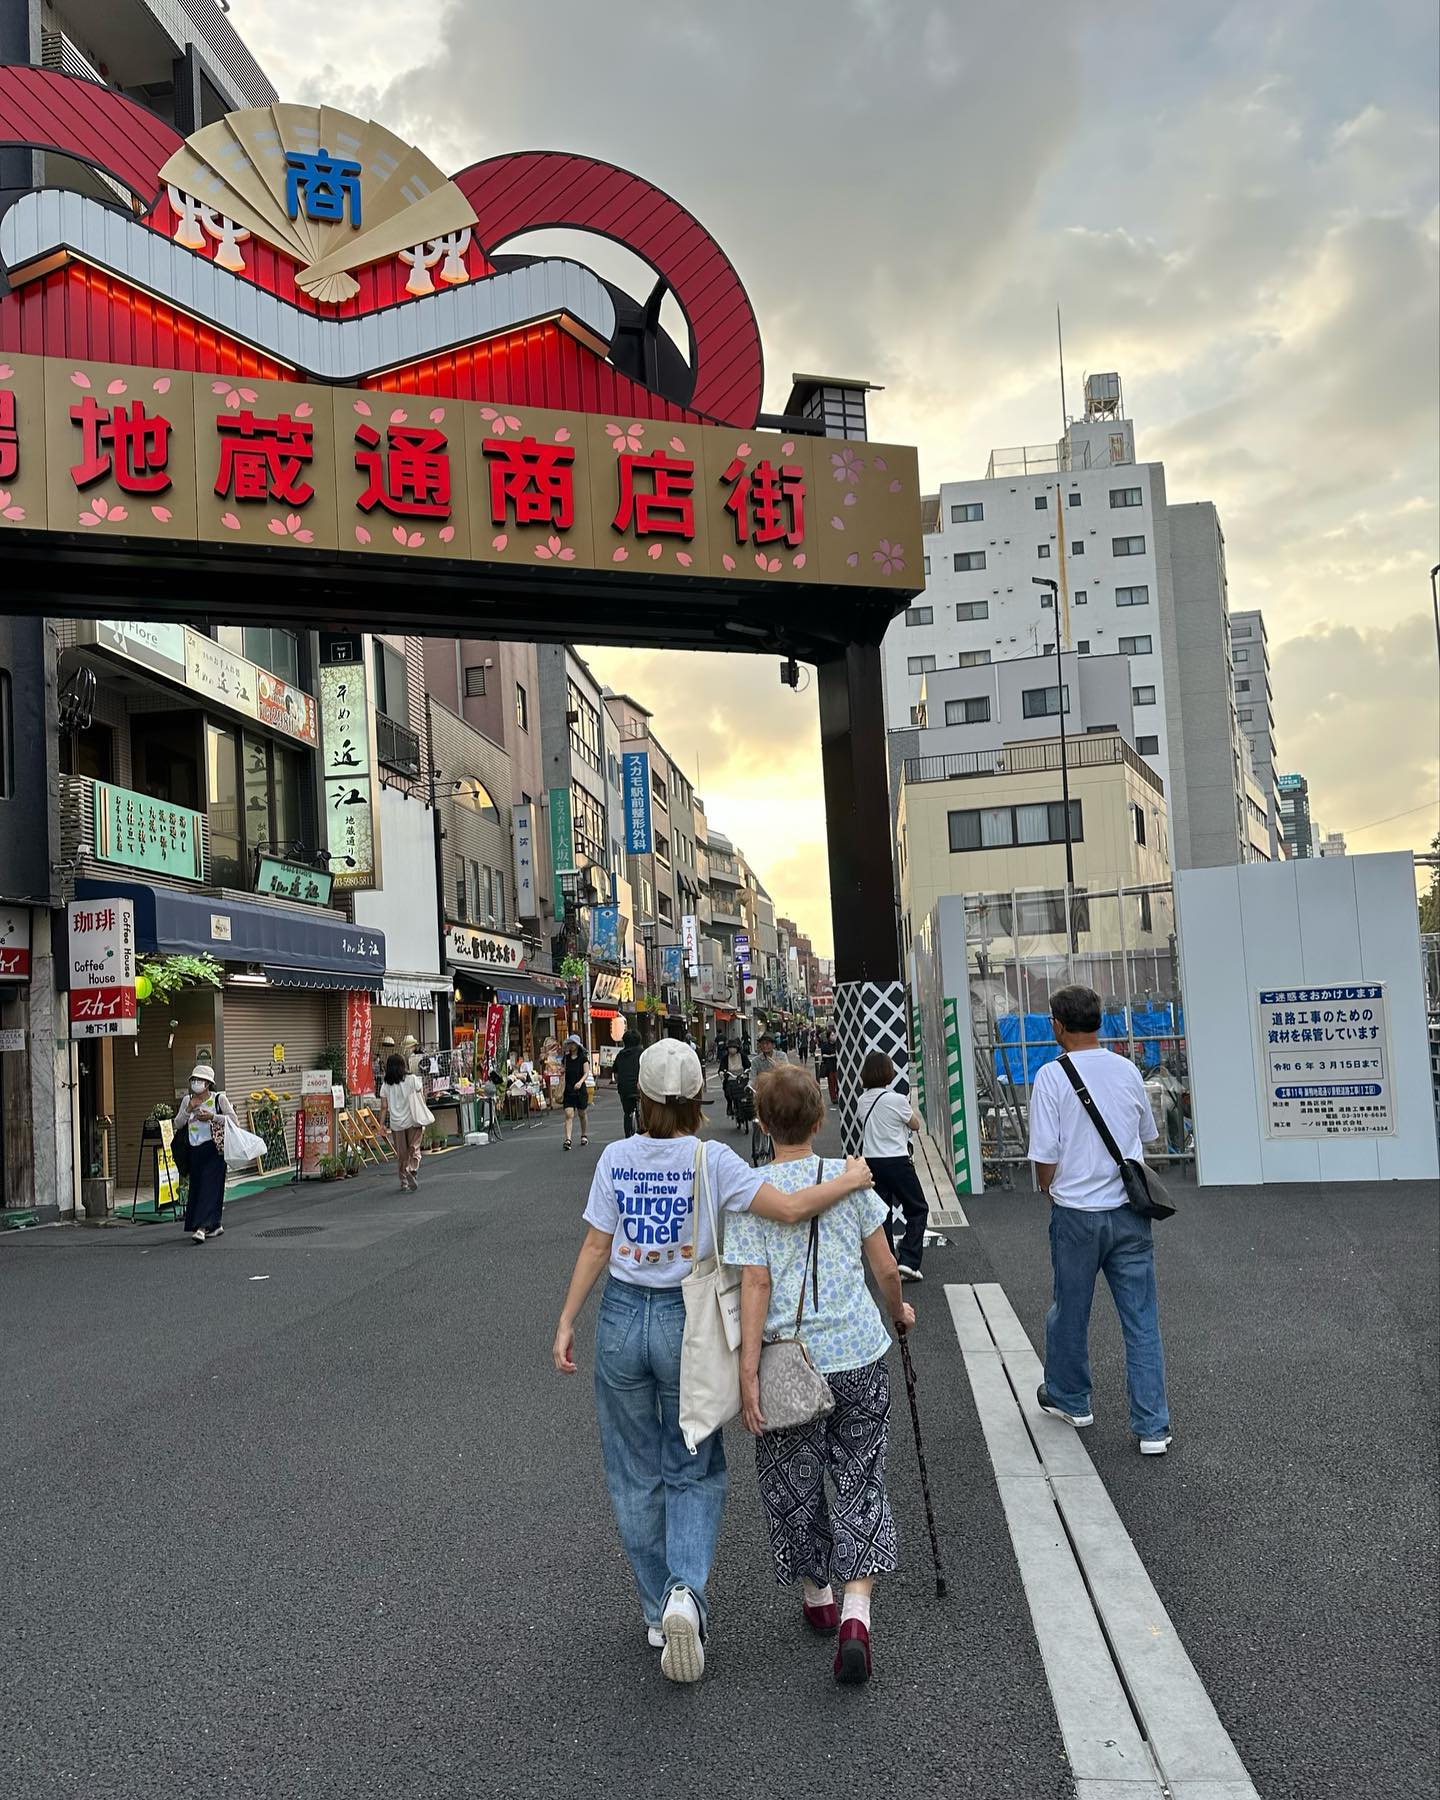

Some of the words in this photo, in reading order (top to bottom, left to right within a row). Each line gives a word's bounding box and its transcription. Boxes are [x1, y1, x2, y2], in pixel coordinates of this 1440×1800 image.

[286, 148, 362, 230] 商
[0, 390, 806, 548] 地蔵通商店街
[129, 621, 158, 645] Flore
[329, 684, 368, 810] そめの近江
[629, 755, 647, 851] スガモ駅前整形外科
[345, 815, 356, 856] 地蔵通り
[73, 908, 116, 933] 珈琲
[122, 911, 132, 944] Coffee
[74, 960, 105, 973] Coffee
[123, 947, 132, 978] House
[88, 974, 116, 985] House
[75, 991, 121, 1017] スカイ
[1264, 987, 1379, 1003] ご迷惑をおかけします
[85, 1022, 119, 1035] 地下1階
[1272, 1008, 1374, 1026] 道路工事のための
[1268, 1025, 1380, 1044] 資材を保管しています
[611, 1167, 664, 1181] Welcome
[666, 1170, 680, 1182] to
[633, 1181, 678, 1195] all-new
[623, 1217, 685, 1245] Chef
